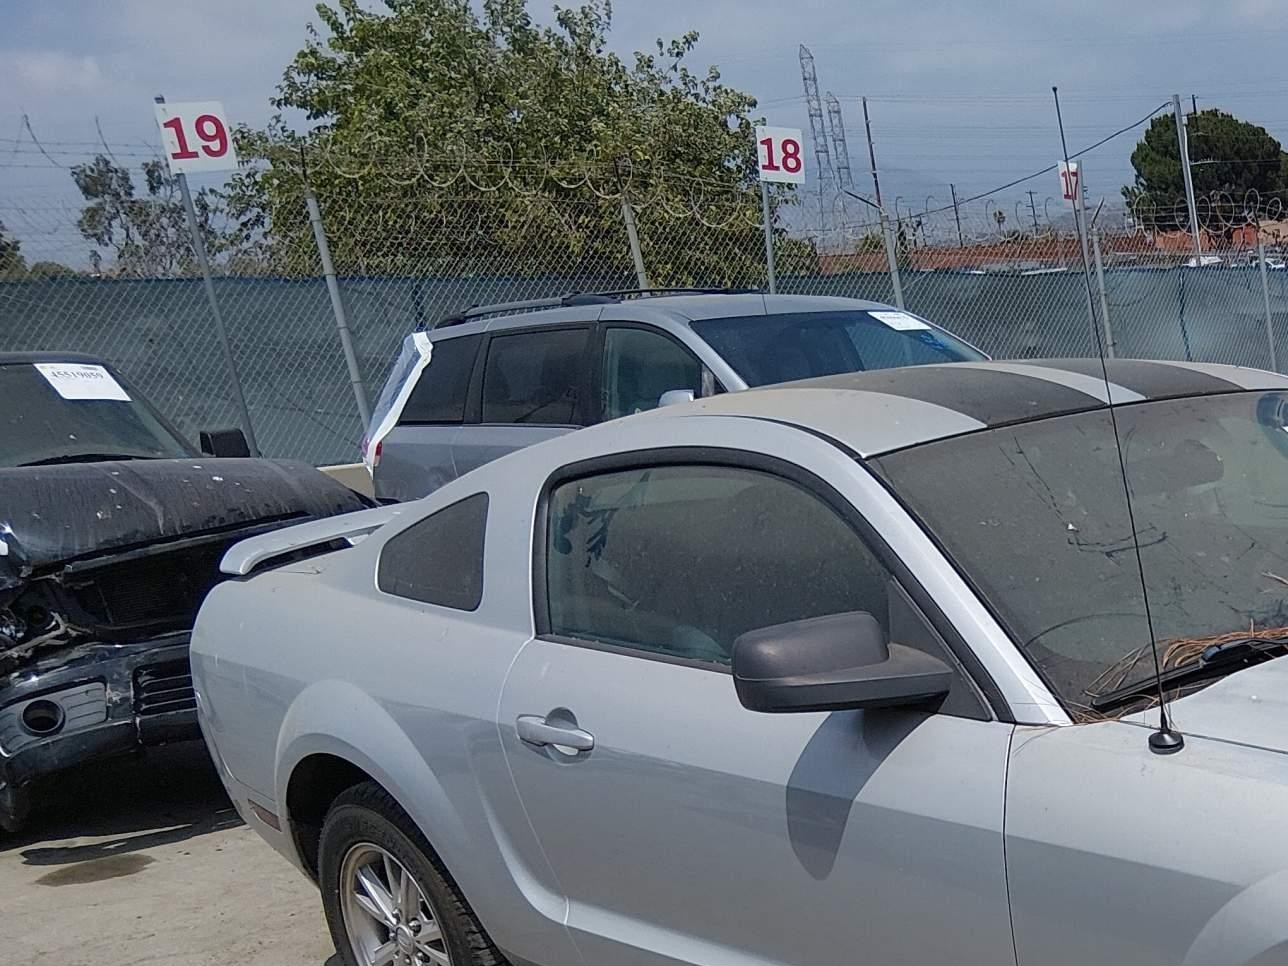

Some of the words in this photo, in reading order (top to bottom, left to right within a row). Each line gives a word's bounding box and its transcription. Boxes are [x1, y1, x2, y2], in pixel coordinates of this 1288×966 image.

[163, 114, 229, 160] 19
[760, 137, 802, 174] 18
[1061, 170, 1079, 201] 17
